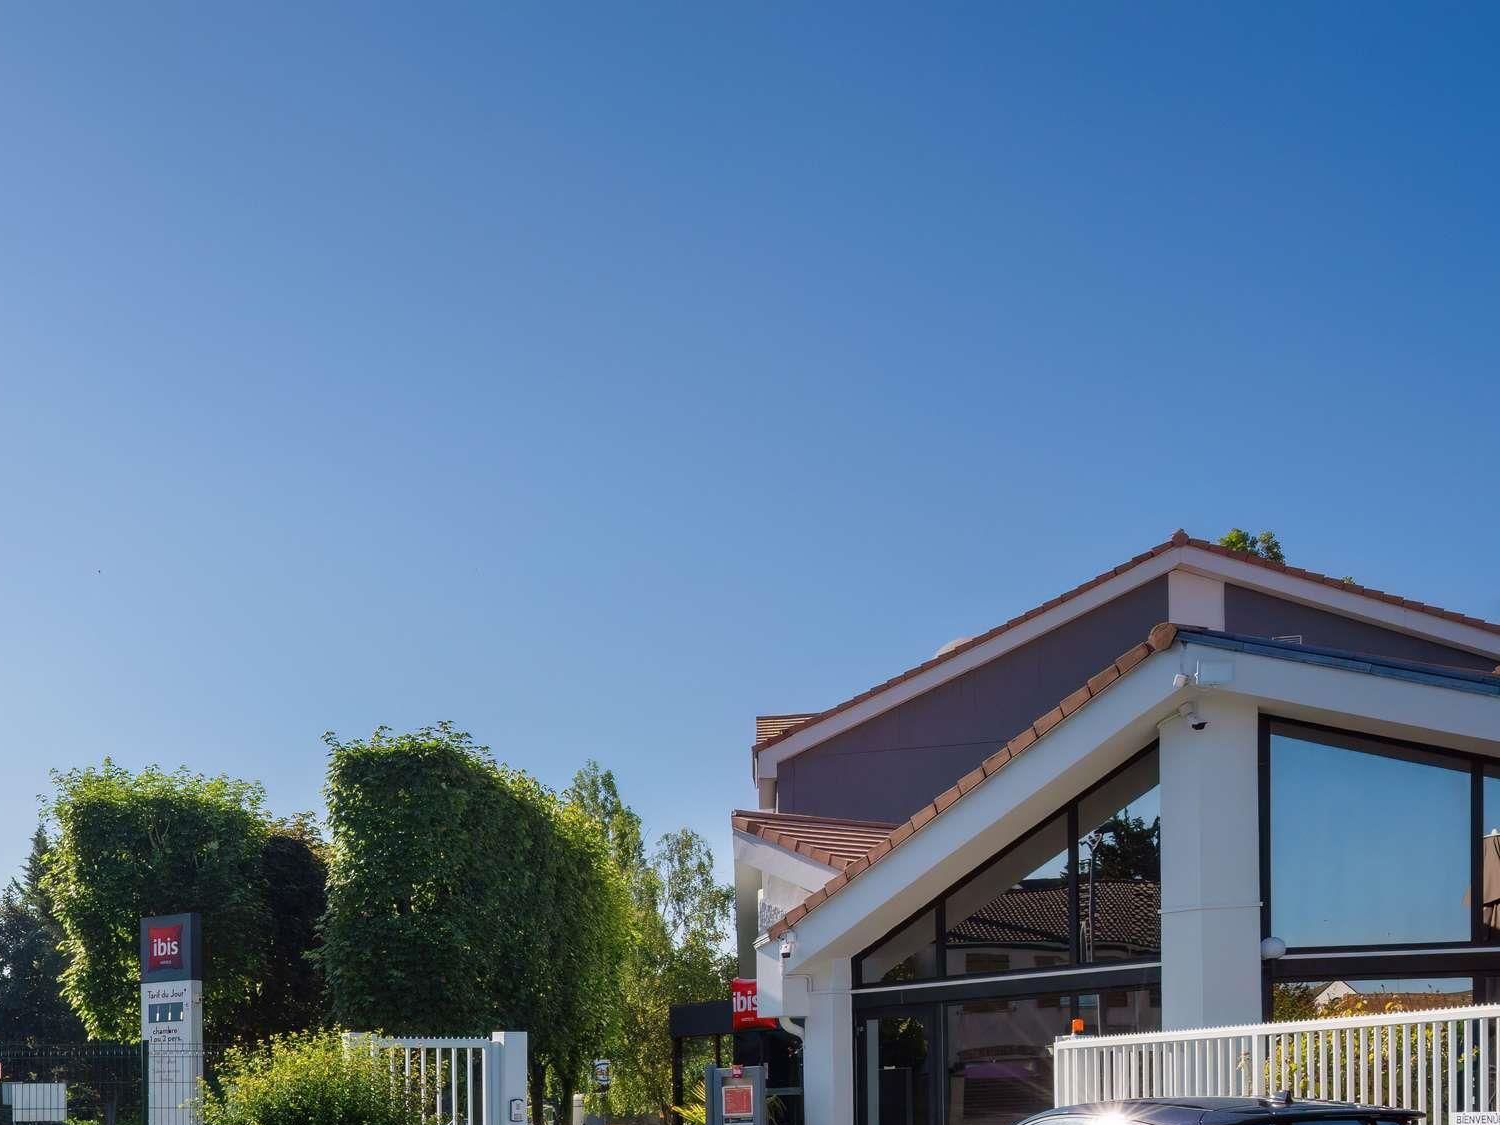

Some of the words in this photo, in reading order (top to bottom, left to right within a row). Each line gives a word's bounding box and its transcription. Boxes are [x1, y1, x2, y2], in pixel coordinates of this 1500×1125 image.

[153, 937, 178, 957] ibis
[162, 988, 169, 998] du
[732, 991, 757, 1013] ibis
[152, 1026, 178, 1035] chambre
